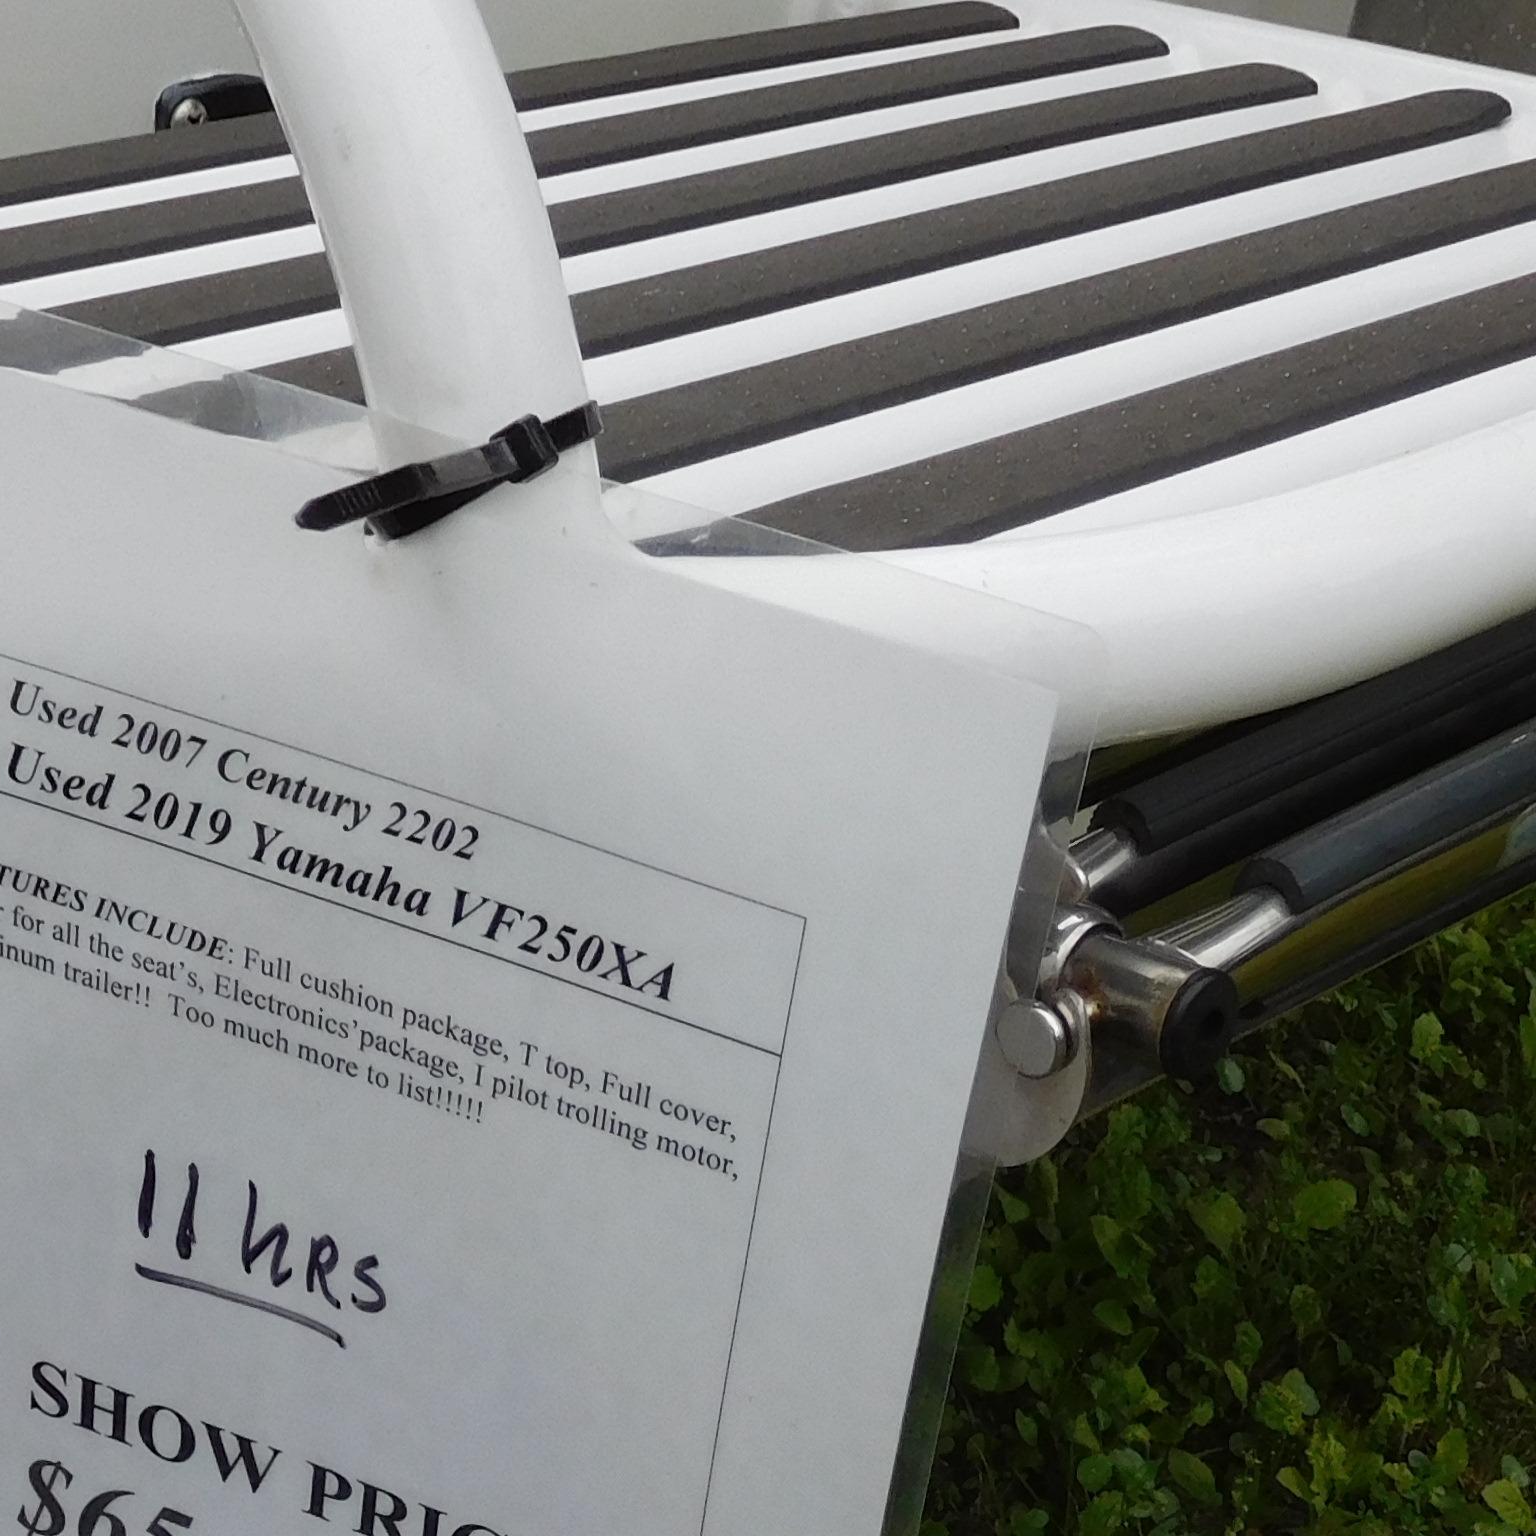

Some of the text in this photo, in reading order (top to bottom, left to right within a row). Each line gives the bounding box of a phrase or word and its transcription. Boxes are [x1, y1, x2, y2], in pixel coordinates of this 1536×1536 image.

[6, 743, 677, 1002] Used 2019 Yamaha VF250XA
[10, 679, 481, 862] Used 2007 Century 2202
[13, 906, 44, 934] for
[53, 922, 80, 947] all
[89, 932, 123, 961] the
[131, 952, 204, 993] seat's,
[474, 1064, 485, 1087] I
[492, 1075, 550, 1110] pilot
[557, 1095, 648, 1150] trolling
[656, 1134, 738, 1181] motor,
[64, 960, 150, 1008] trailer!!
[168, 994, 215, 1028] Too
[223, 1017, 289, 1054] much
[298, 1042, 359, 1078] more
[367, 1066, 389, 1089] to
[94, 897, 235, 965] INCLUDE:
[244, 947, 291, 983] Full
[301, 971, 393, 1018] cushion
[402, 1007, 508, 1062] package,
[520, 1041, 538, 1067] T
[546, 1054, 589, 1091] top,
[601, 1071, 650, 1109] Full
[659, 1098, 736, 1143] cover,
[30, 1361, 282, 1494] SHOW
